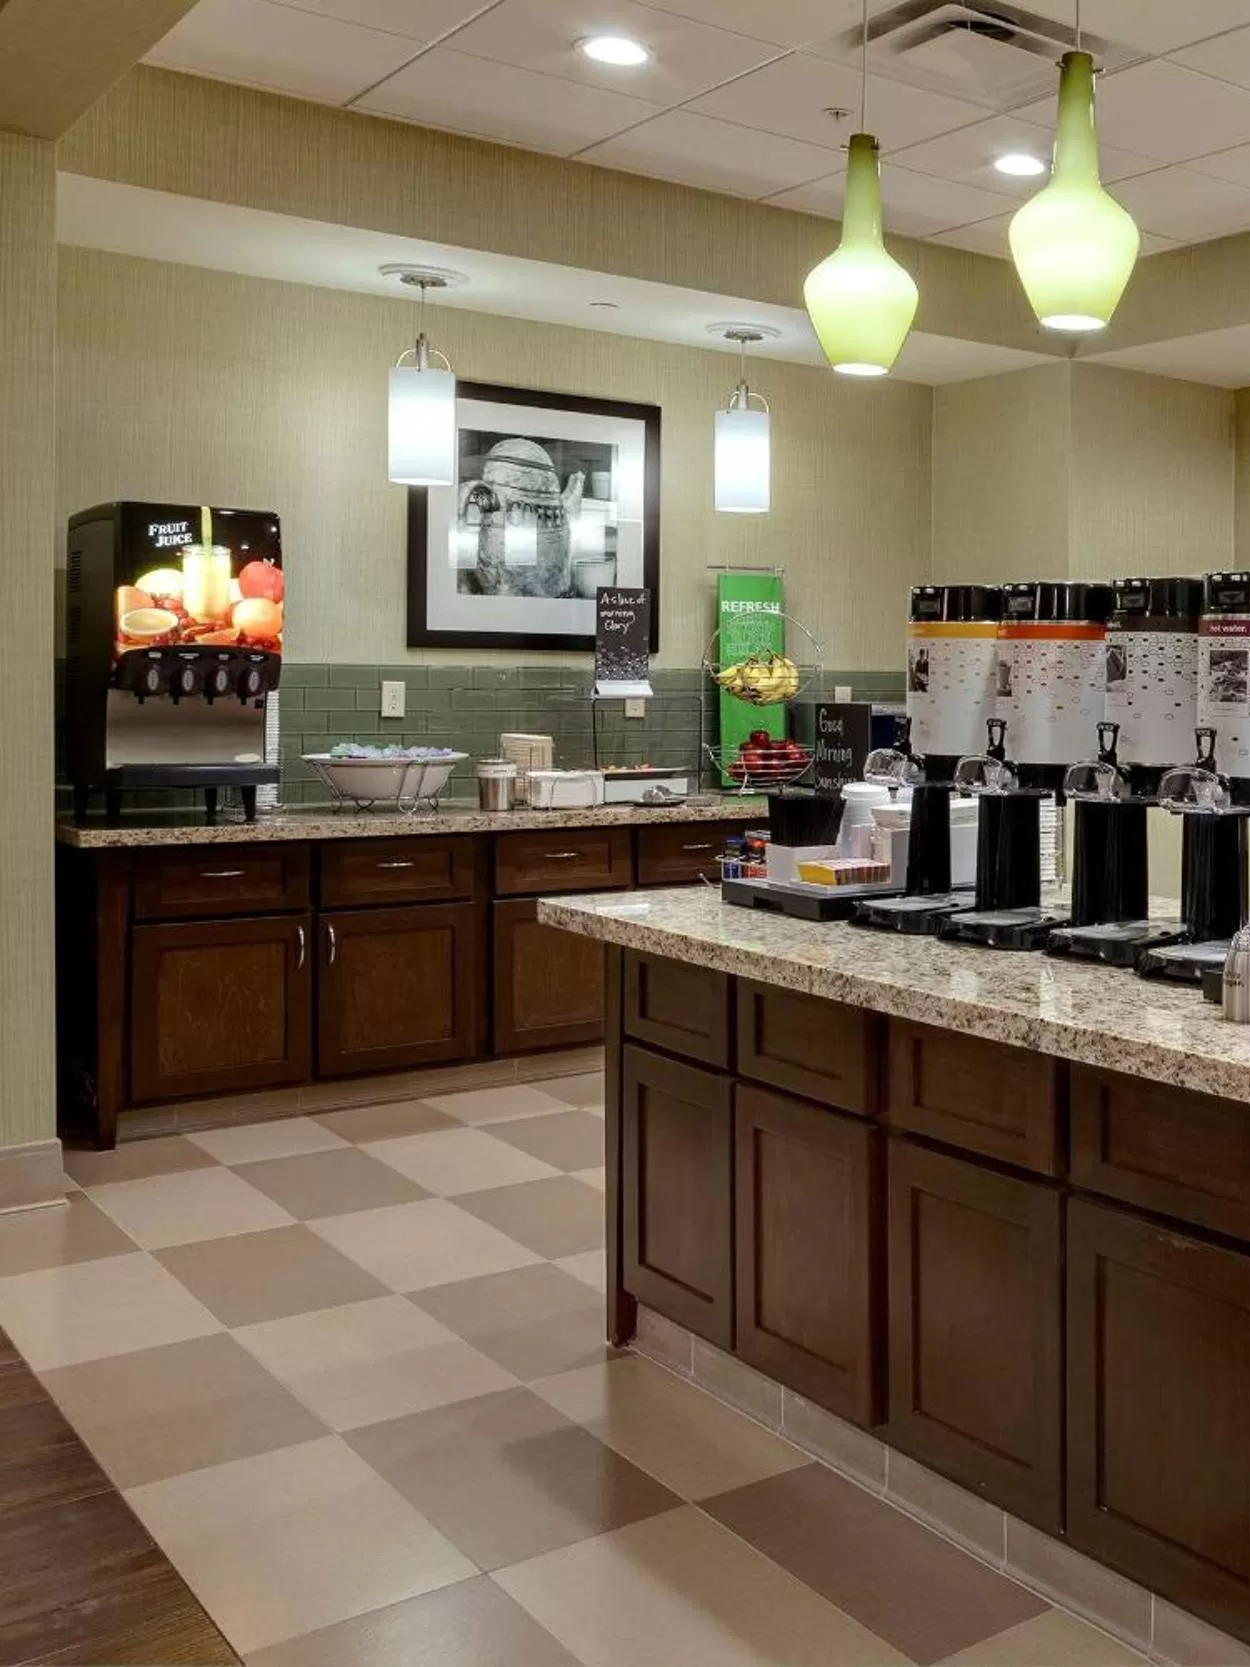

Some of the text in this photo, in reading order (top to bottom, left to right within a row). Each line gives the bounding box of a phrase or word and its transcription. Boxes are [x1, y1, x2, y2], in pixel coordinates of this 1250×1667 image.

[148, 521, 189, 536] FRUIT
[155, 533, 193, 548] JUICE
[600, 592, 609, 604] A
[721, 600, 780, 613] REFRESH
